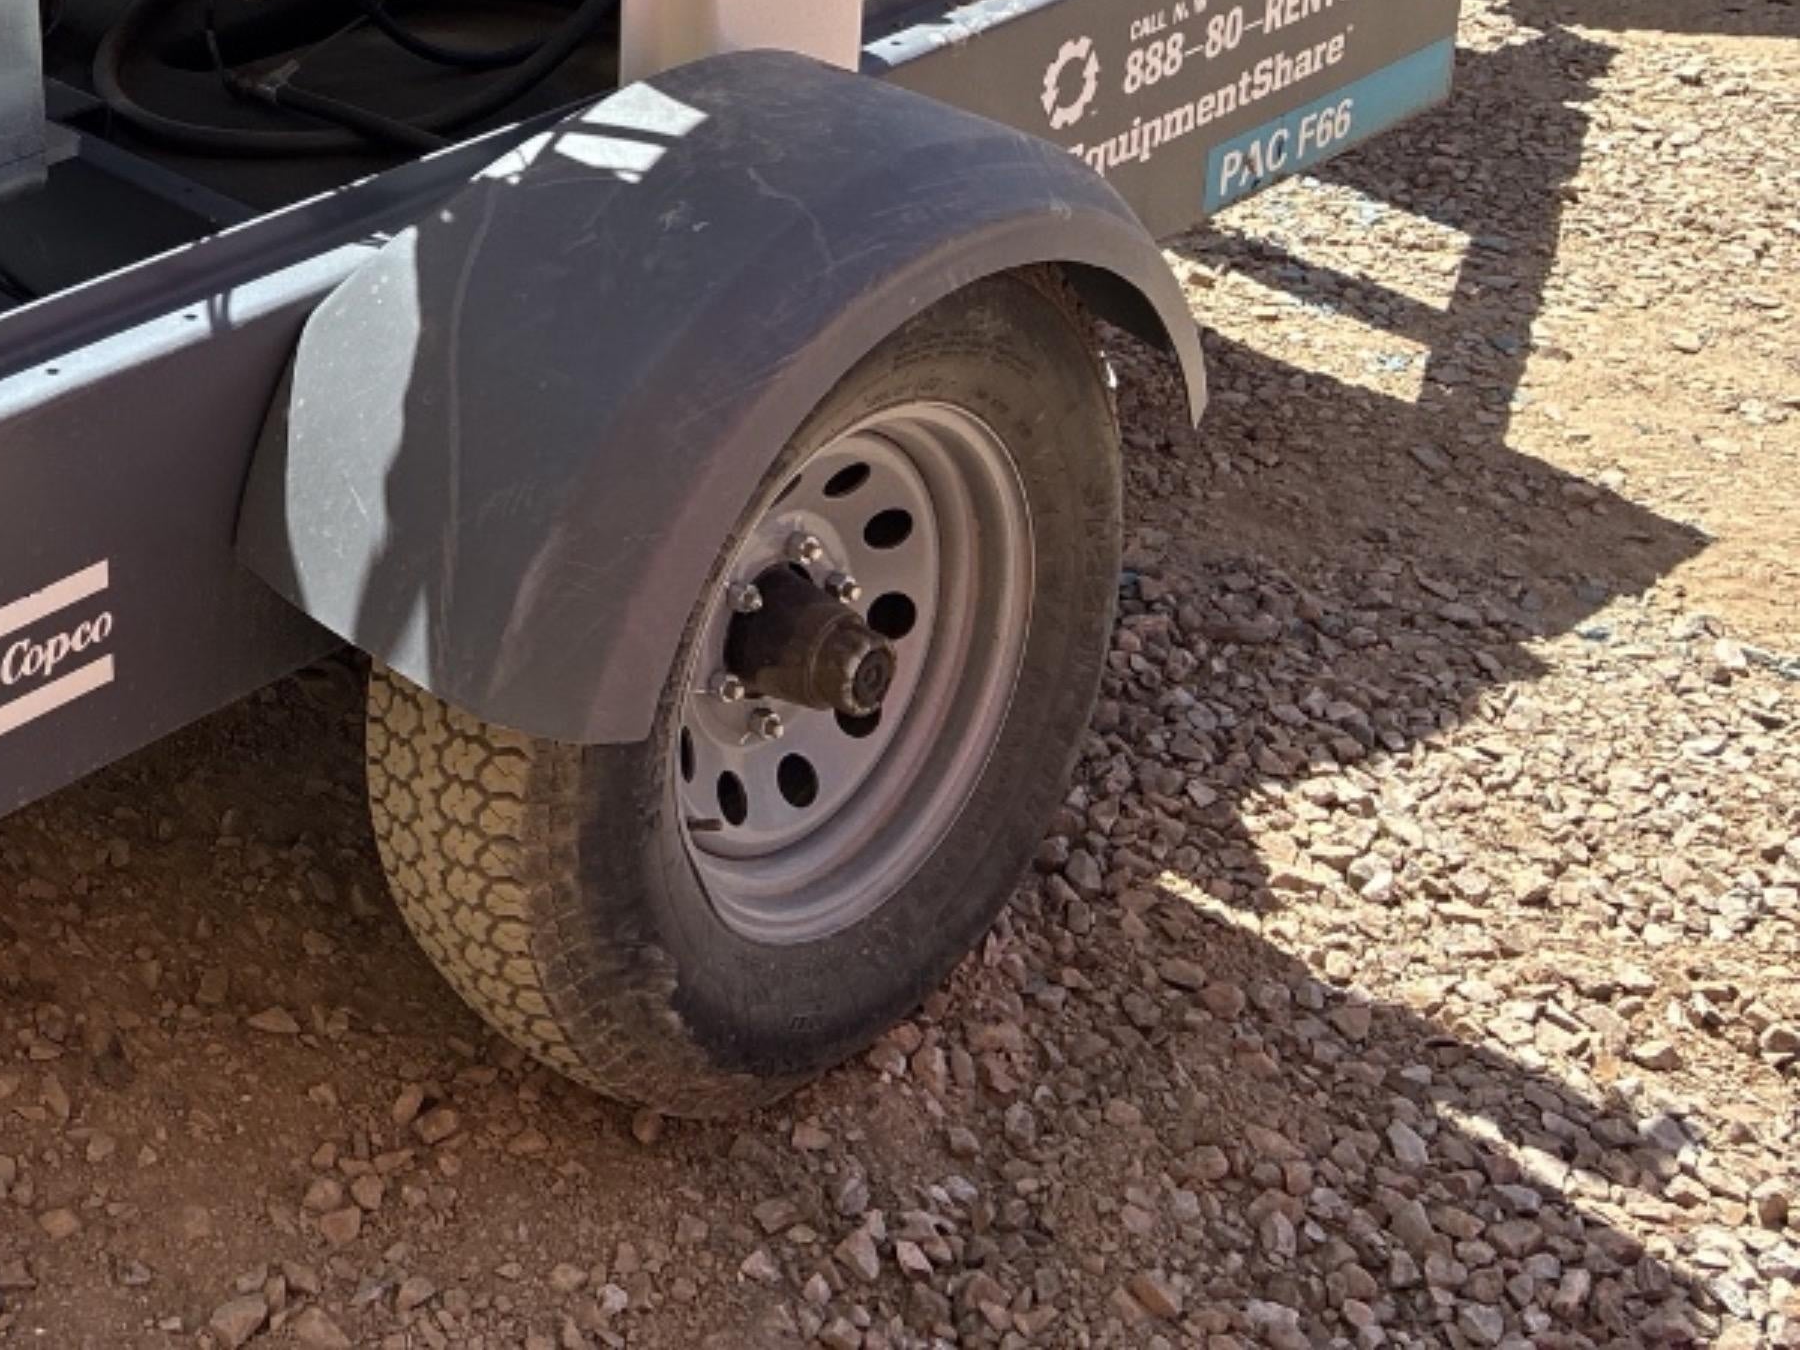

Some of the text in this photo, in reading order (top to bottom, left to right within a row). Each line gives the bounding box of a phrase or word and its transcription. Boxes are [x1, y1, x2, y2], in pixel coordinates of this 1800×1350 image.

[1130, 9, 1167, 41] CALL
[1220, 98, 1354, 196] PAC F66
[0, 610, 113, 686] Copco
